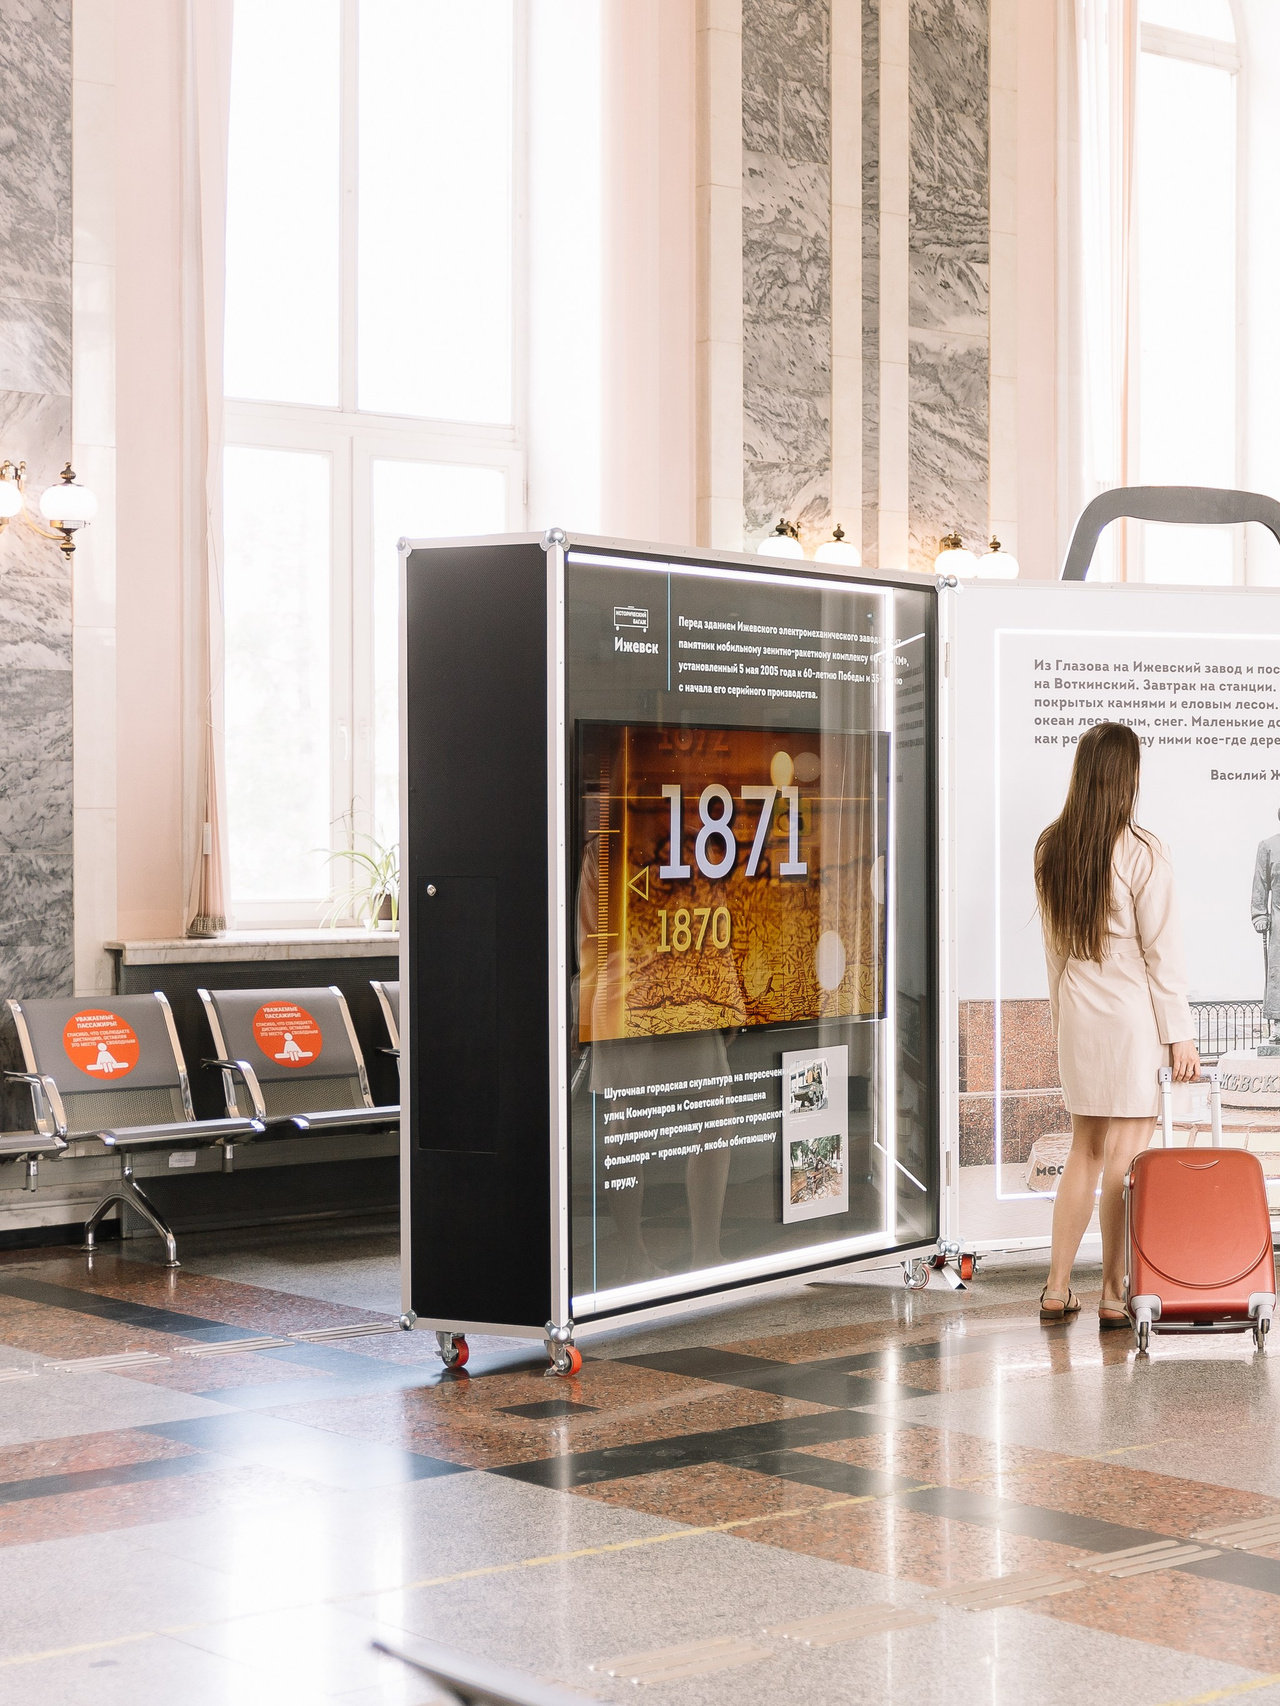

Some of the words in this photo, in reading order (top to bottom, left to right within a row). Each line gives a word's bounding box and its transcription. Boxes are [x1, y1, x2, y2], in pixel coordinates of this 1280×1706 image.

[632, 618, 647, 626] БАГАЖ
[678, 616, 702, 630] Перед
[704, 621, 736, 632] зданием
[738, 621, 778, 635] Ижевского
[779, 627, 858, 642] электромеханического
[614, 636, 659, 654] Ижевск
[678, 640, 716, 651] памятник
[716, 641, 762, 657] мобильному
[763, 647, 832, 662] зенитно-ракетному
[832, 654, 868, 666] комплексу
[678, 662, 738, 674] установленный
[739, 664, 744, 674] 5
[746, 666, 759, 675] мая
[760, 665, 778, 676] 2005
[780, 669, 796, 678] года
[803, 668, 838, 681] 60-летию
[838, 670, 865, 683] Победы
[1034, 659, 1052, 671] Из
[1056, 660, 1110, 672] Глазова
[1114, 663, 1129, 672] на
[1134, 661, 1200, 673] Ижевский
[1204, 665, 1242, 675] завод
[1246, 666, 1254, 674] и
[678, 684, 684, 692] с
[685, 684, 712, 694] начала
[714, 685, 726, 694] его
[728, 686, 766, 698] серийного
[768, 688, 818, 700] производства.
[1034, 680, 1050, 689] на
[1054, 678, 1140, 690] Воткинский.
[1143, 679, 1196, 694] Завтрак
[1200, 682, 1216, 691] на
[1219, 683, 1276, 692] станции.
[1034, 698, 1104, 711] покрытых
[1108, 700, 1166, 708] камнями
[1170, 700, 1177, 708] и
[1181, 700, 1232, 710] еловым
[1235, 701, 1278, 710] лесом.
[1034, 717, 1074, 726] океан
[1154, 718, 1188, 726] снег.
[1192, 716, 1264, 727] Маленькие
[1034, 736, 1058, 744] как
[1158, 736, 1192, 744] ними
[1196, 736, 1246, 746] кое-где
[1210, 769, 1267, 780] Василий
[660, 784, 807, 879] 1871
[656, 906, 731, 952] 1870
[75, 1014, 114, 1022] УВАЖАЕМЫЕ
[604, 1086, 645, 1101] Шуточная
[646, 1080, 688, 1096] городская
[689, 1074, 733, 1090] скульптура
[734, 1072, 744, 1082] на
[604, 1110, 624, 1124] улиц
[626, 1104, 676, 1119] Коммунаров
[676, 1103, 682, 1111] и
[684, 1094, 724, 1110] Советской
[726, 1092, 766, 1104] посвящена
[604, 1128, 658, 1146] популярному
[660, 1122, 703, 1138] персонажу
[704, 1116, 744, 1129] ижевского
[746, 1109, 786, 1125] городского
[604, 1151, 650, 1170] фольклора
[658, 1144, 703, 1160] крокодилу,
[704, 1137, 728, 1150] якобы
[730, 1132, 776, 1147] обитающему
[1036, 1165, 1064, 1176] мес
[604, 1180, 610, 1190] в
[611, 1176, 638, 1191] пруду.
